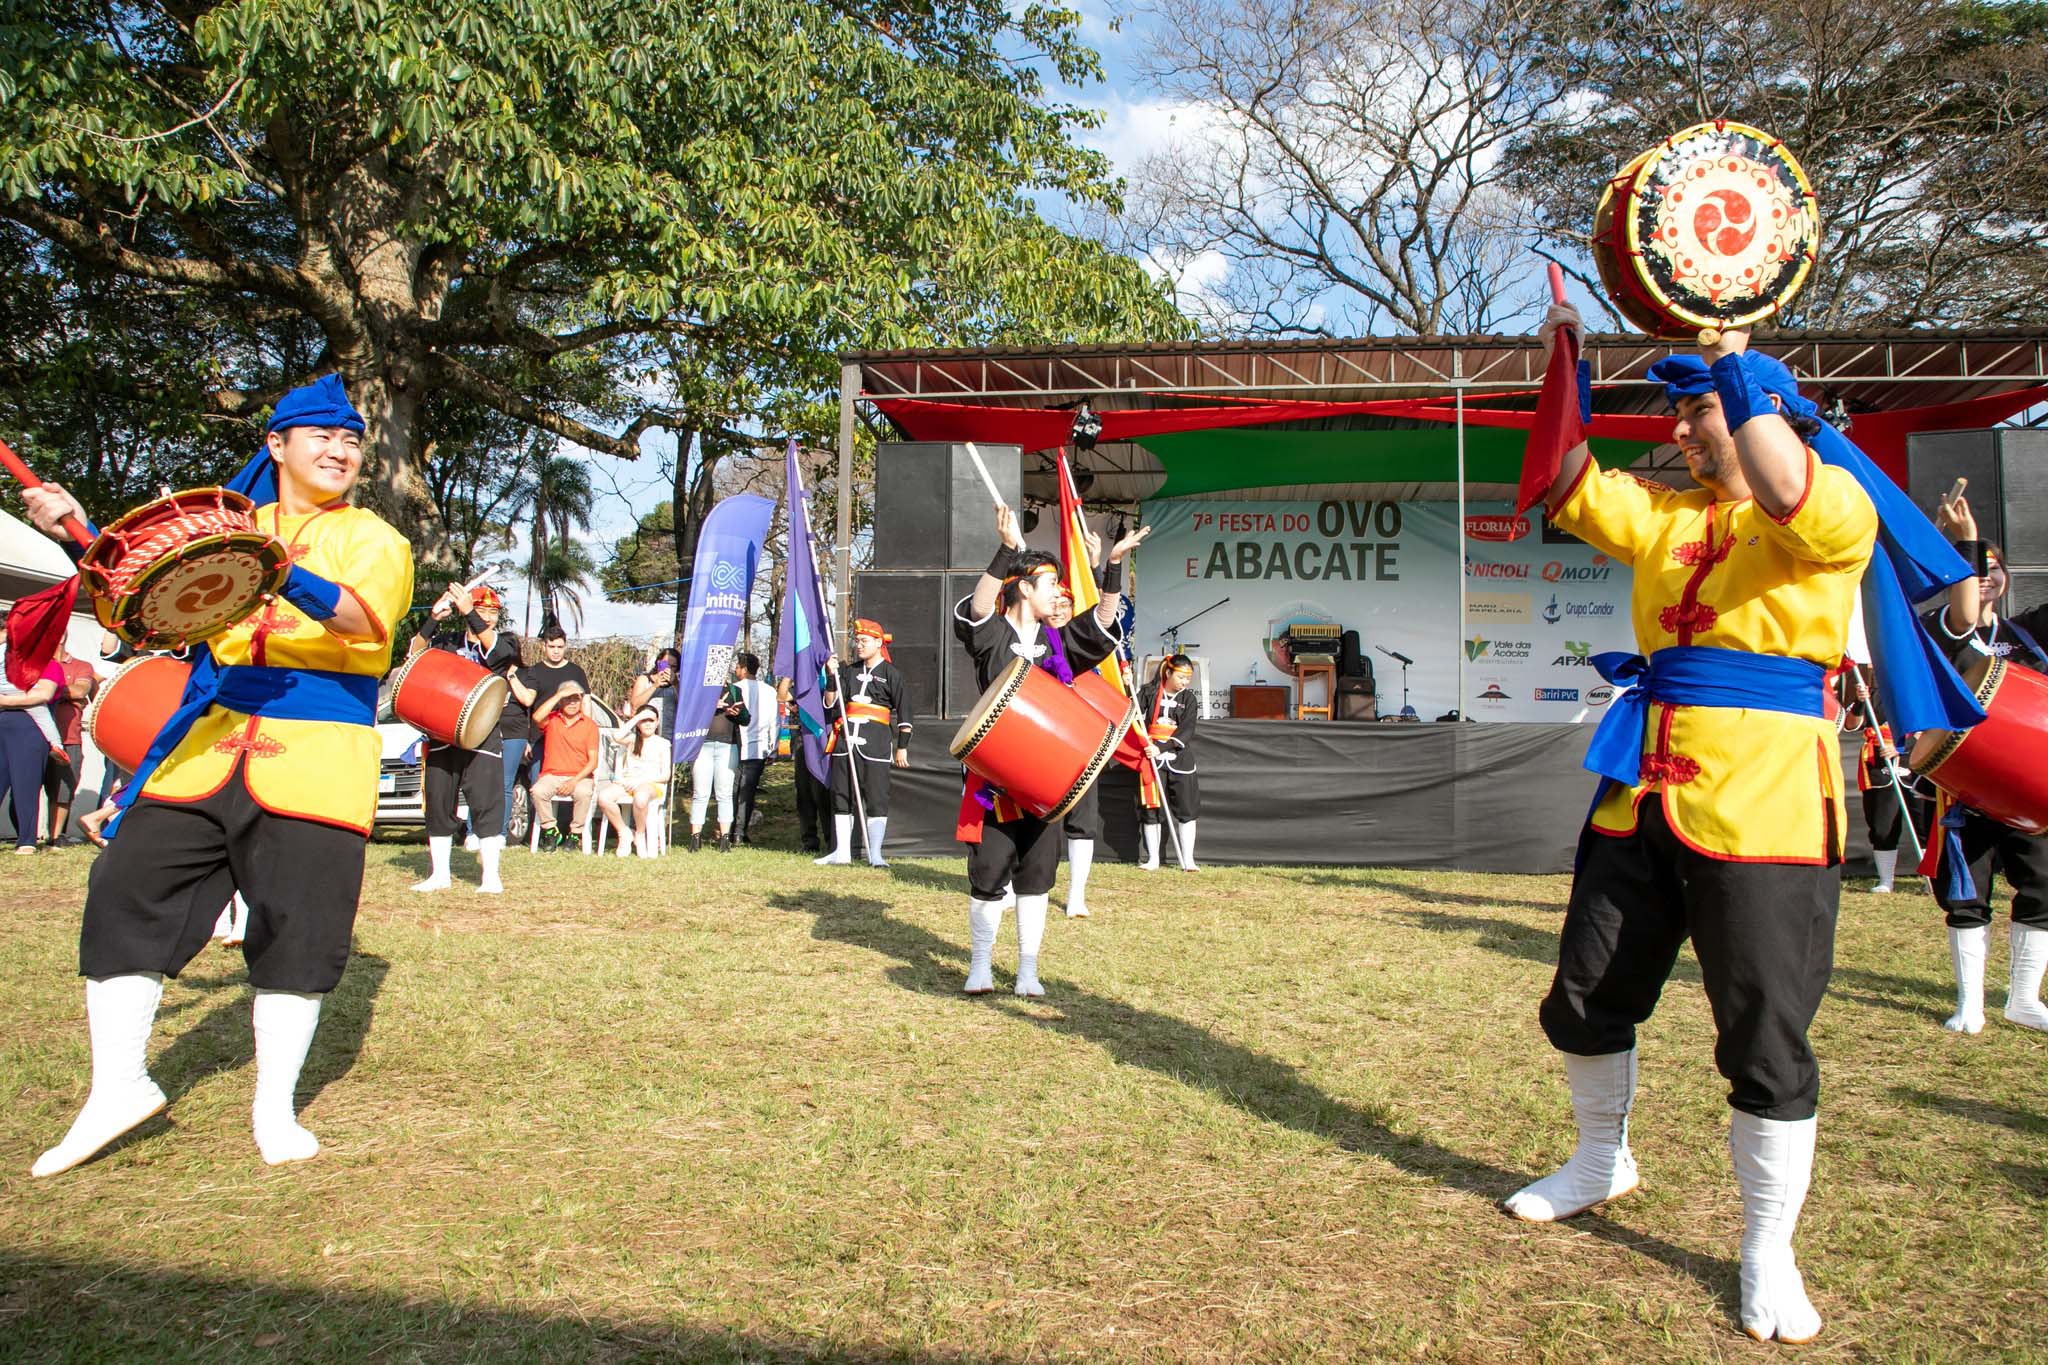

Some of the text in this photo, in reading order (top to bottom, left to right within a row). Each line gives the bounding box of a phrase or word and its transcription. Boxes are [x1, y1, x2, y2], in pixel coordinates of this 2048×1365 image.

[1193, 500, 1402, 538] 7ª FESTA DO OVO
[1465, 521, 1526, 532] FLORIANI
[1186, 541, 1400, 581] E ABACATE
[1473, 563, 1529, 578] NICIOLI
[1566, 602, 1587, 616] Grupo
[1494, 641, 1531, 649] Vale das
[1535, 688, 1577, 700] Bariri PVC
